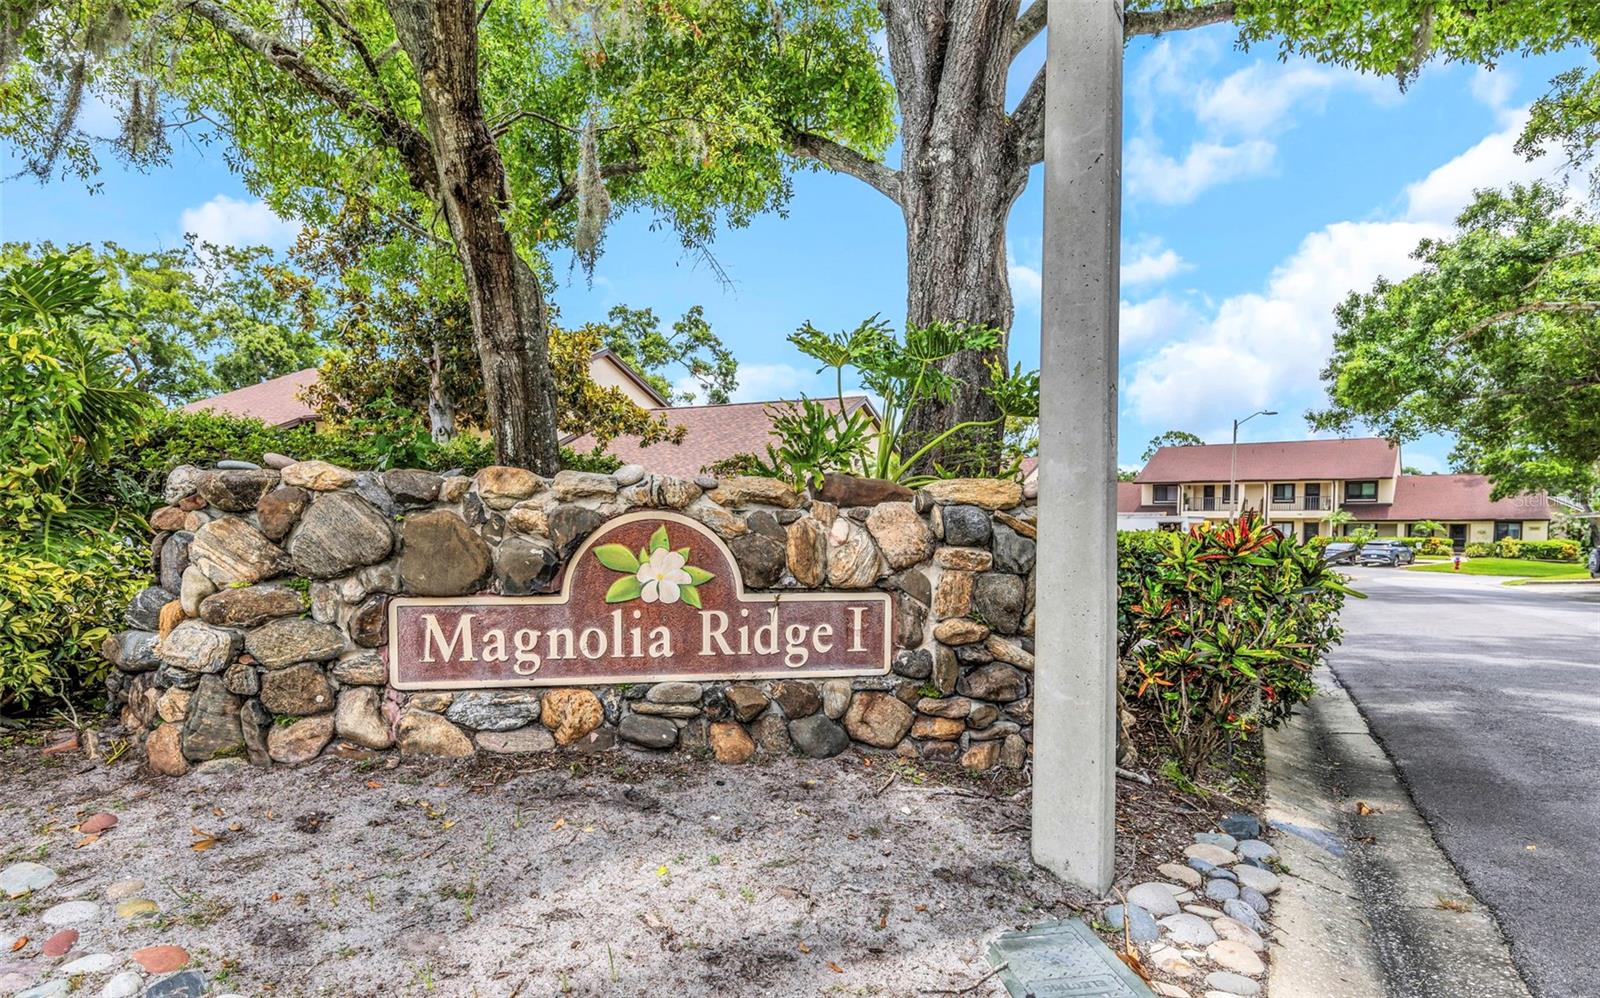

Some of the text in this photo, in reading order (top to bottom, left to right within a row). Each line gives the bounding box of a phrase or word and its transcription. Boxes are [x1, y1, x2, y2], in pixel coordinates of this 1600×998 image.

[421, 606, 868, 675] Magnolia Ridge I
